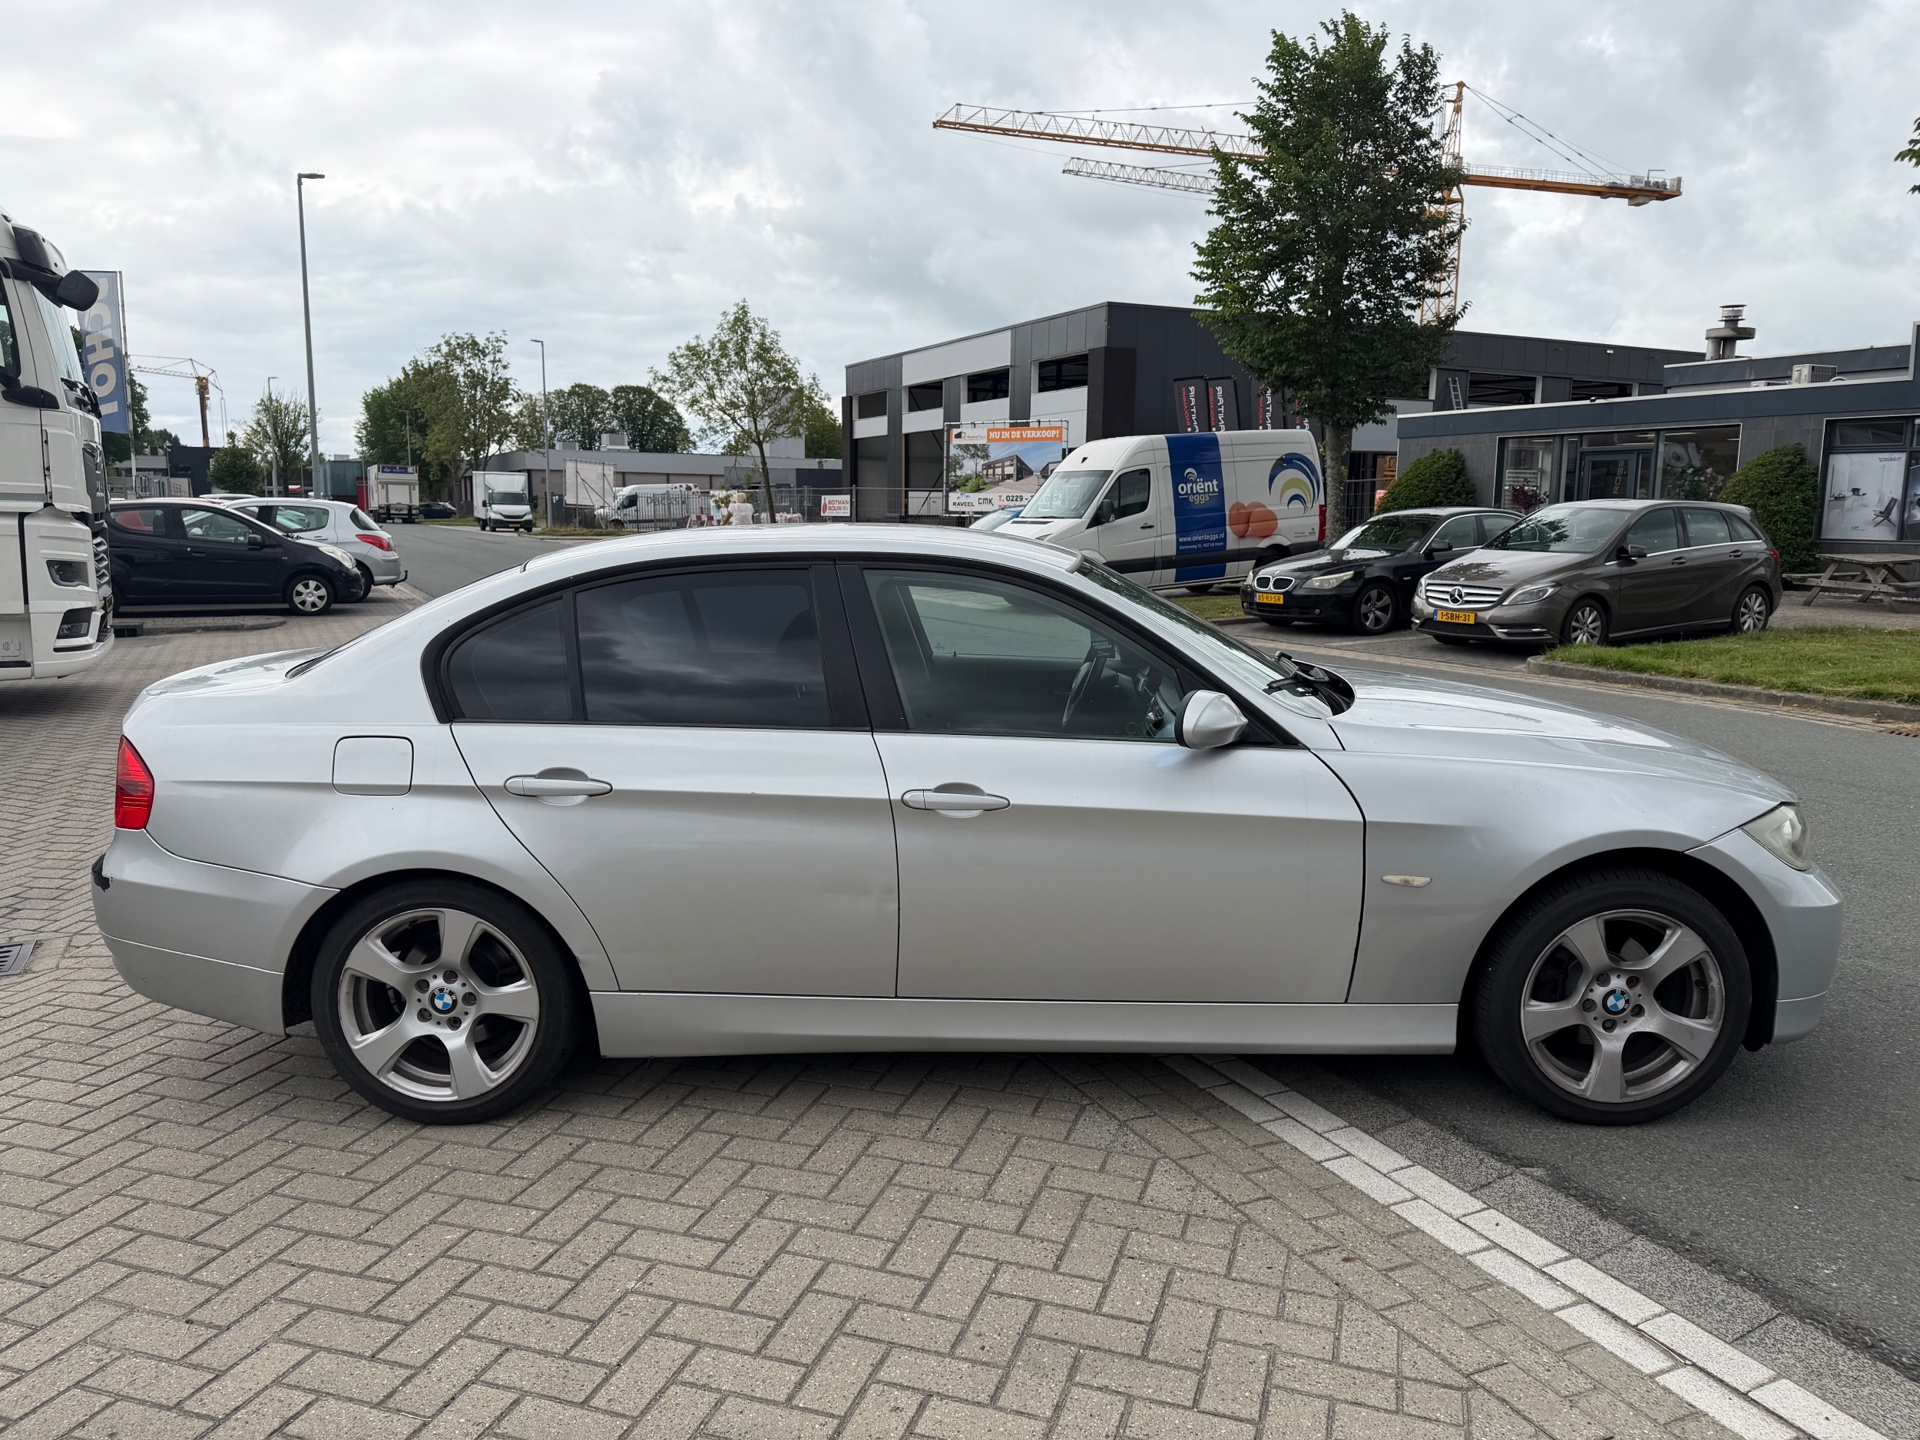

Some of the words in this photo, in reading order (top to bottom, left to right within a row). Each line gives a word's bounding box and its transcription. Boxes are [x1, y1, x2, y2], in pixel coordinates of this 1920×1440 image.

[989, 430, 1001, 439] NU
[1001, 430, 1010, 439] IN
[1011, 430, 1021, 439] DE
[1021, 429, 1060, 438] VERKOOP!
[1178, 478, 1219, 494] oriënt
[977, 497, 994, 506] CMK
[1189, 493, 1209, 504] eggs
[1440, 611, 1470, 622] 1-SBH-31
